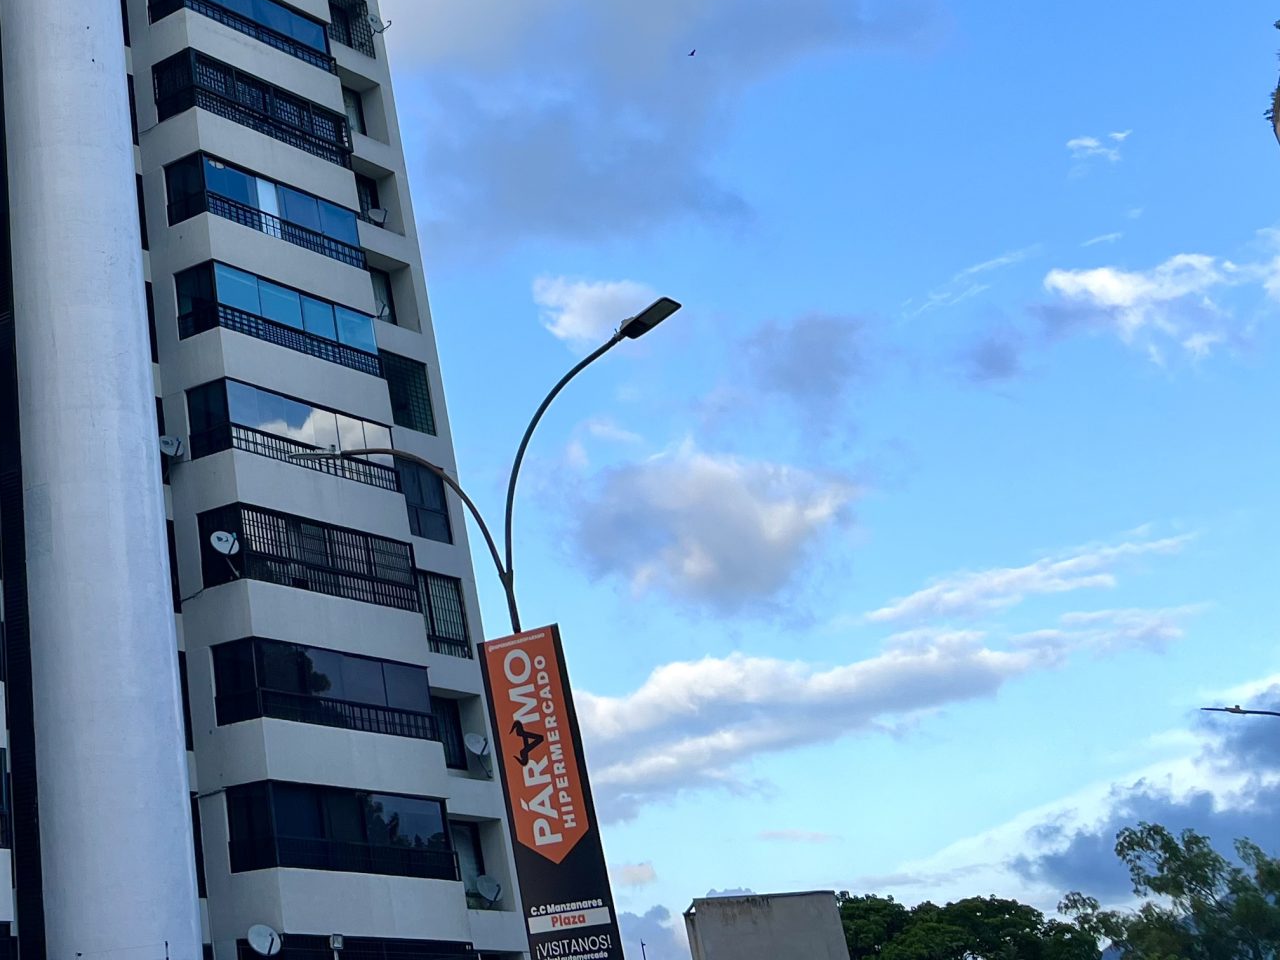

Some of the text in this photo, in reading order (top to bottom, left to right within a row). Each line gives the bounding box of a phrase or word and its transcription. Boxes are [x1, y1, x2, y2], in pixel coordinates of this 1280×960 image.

[533, 655, 577, 828] HIPERMERCADO
[547, 898, 603, 914] Manzanares
[551, 914, 586, 928] Plaza
